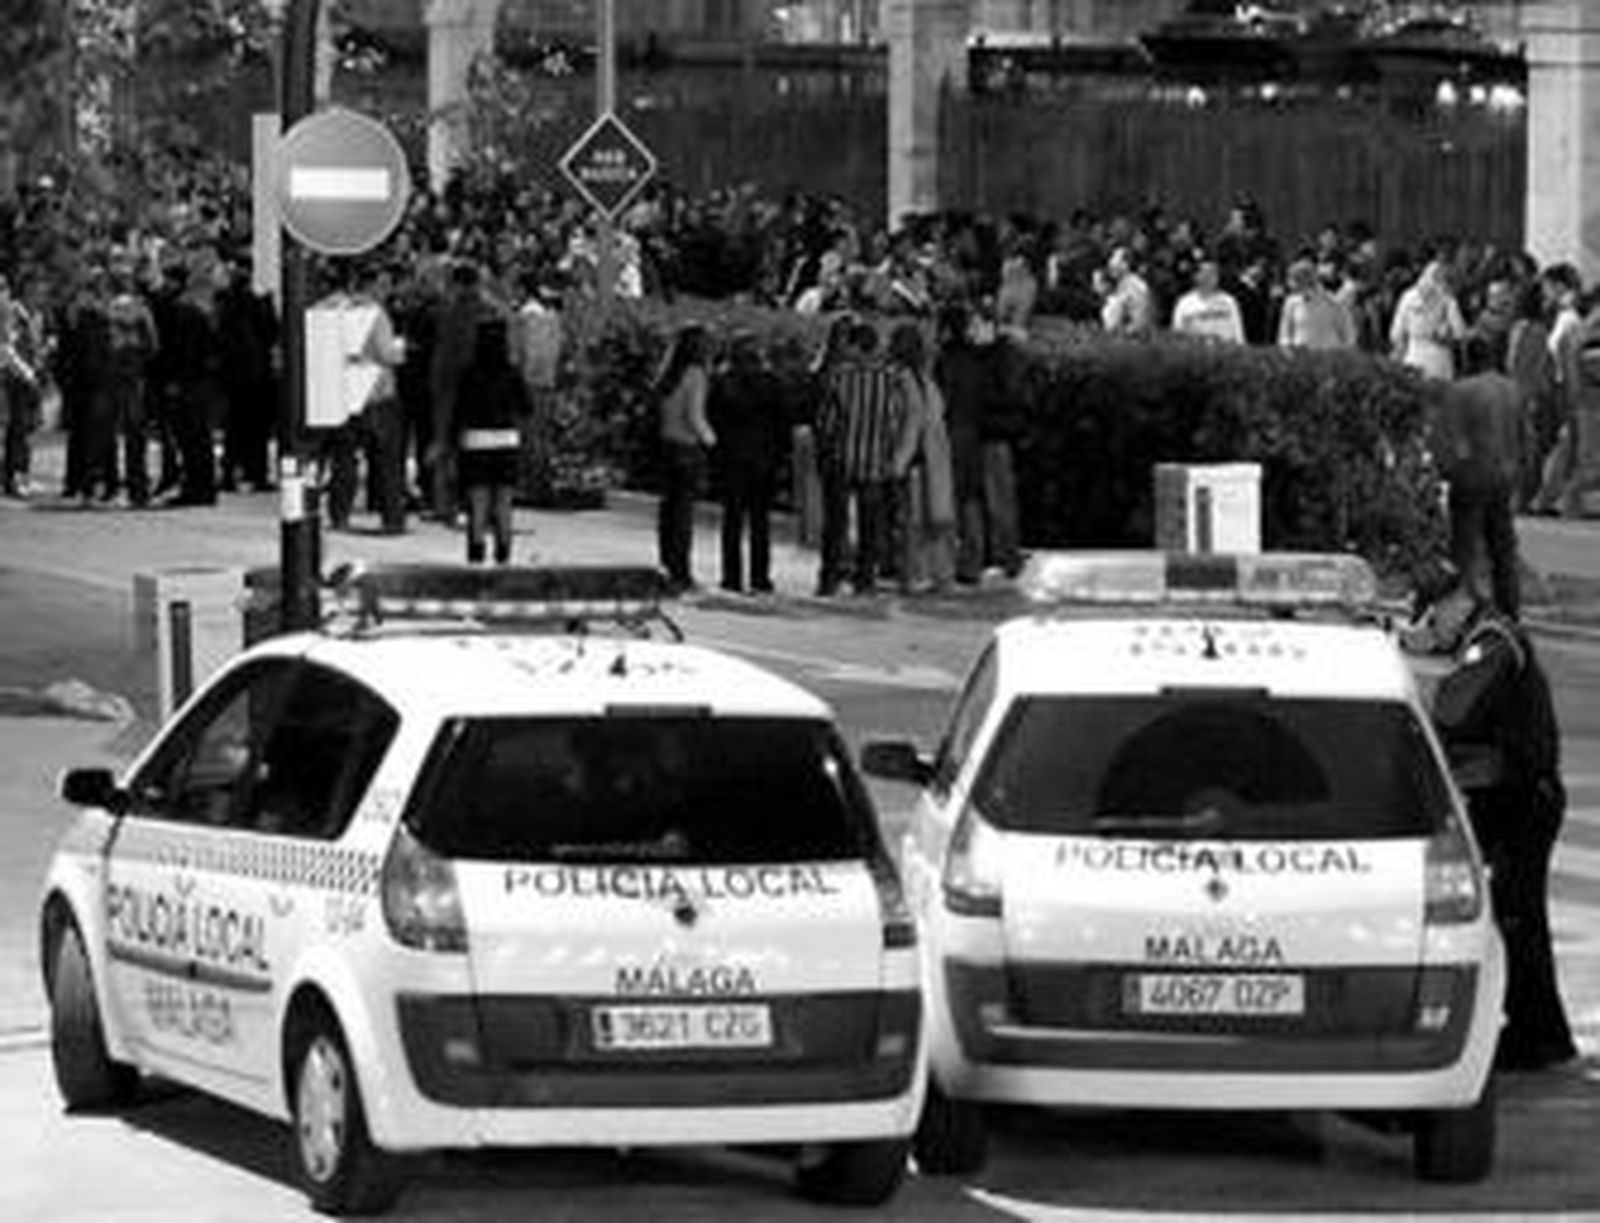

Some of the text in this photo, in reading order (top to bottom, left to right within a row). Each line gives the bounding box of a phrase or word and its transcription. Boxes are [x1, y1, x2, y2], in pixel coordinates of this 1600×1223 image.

[1231, 844, 1371, 874] LOCAL
[504, 865, 840, 899] POLICIA LOCAL
